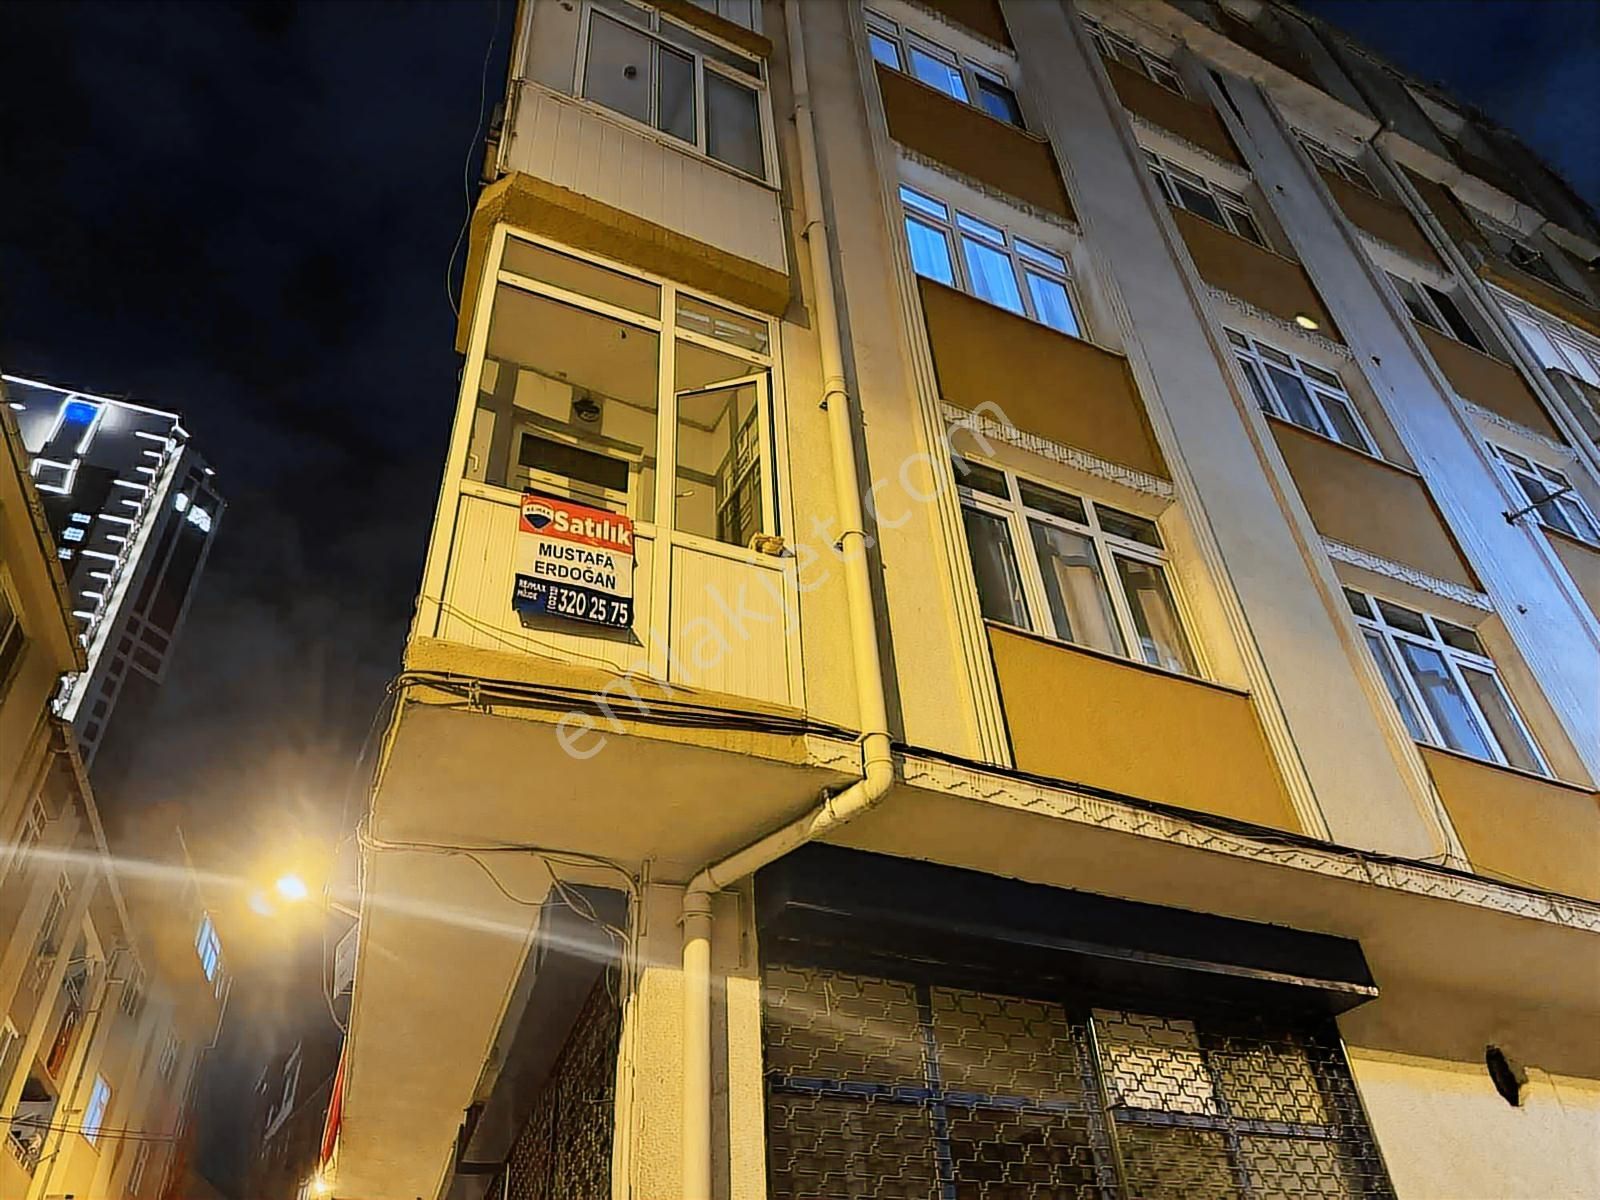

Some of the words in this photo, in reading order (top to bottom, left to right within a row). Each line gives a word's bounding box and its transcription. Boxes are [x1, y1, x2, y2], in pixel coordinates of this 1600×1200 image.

[553, 510, 632, 547] Satılık
[538, 542, 615, 570] MUSTAFA
[534, 560, 616, 590] ERDOĞAN
[558, 588, 586, 616] 320
[589, 596, 607, 621] 25
[610, 601, 628, 624] 75
